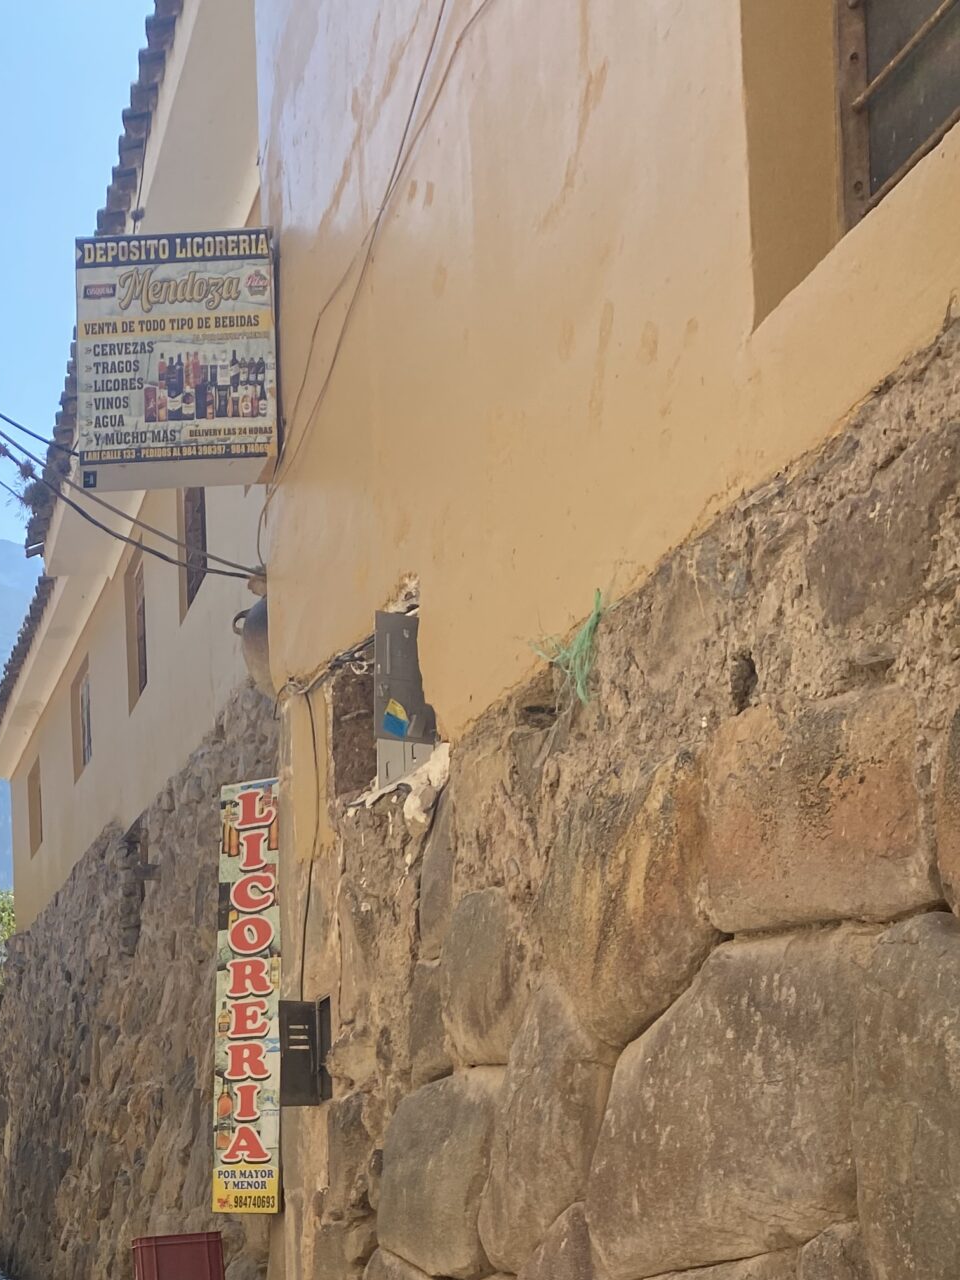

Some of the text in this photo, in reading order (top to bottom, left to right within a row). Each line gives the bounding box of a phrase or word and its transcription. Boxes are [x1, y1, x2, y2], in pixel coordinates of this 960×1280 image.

[83, 233, 269, 264] DEPOSITO LICORERIA
[118, 267, 241, 313] Mendoza
[84, 314, 260, 335] VENTA DE TODO TIPO DE BEBIDAS
[93, 341, 154, 357] CERVEZAS
[93, 359, 140, 374] TRAGOS
[93, 377, 144, 392] LICORES
[93, 396, 129, 410] VINOS
[93, 414, 125, 428] AGUA
[94, 432, 102, 446] Y
[105, 430, 147, 445] MUCHO
[189, 426, 273, 438] DELIVERY LAS 24 HORAS
[101, 449, 122, 460] CALLE
[141, 447, 172, 458] PEDIDOS
[172, 446, 181, 457] AL
[220, 789, 276, 1163] LICORERIA
[217, 1169, 274, 1179] POR MAYOR
[223, 1180, 267, 1190] Y MENOR
[233, 1195, 275, 1209] 984740693
